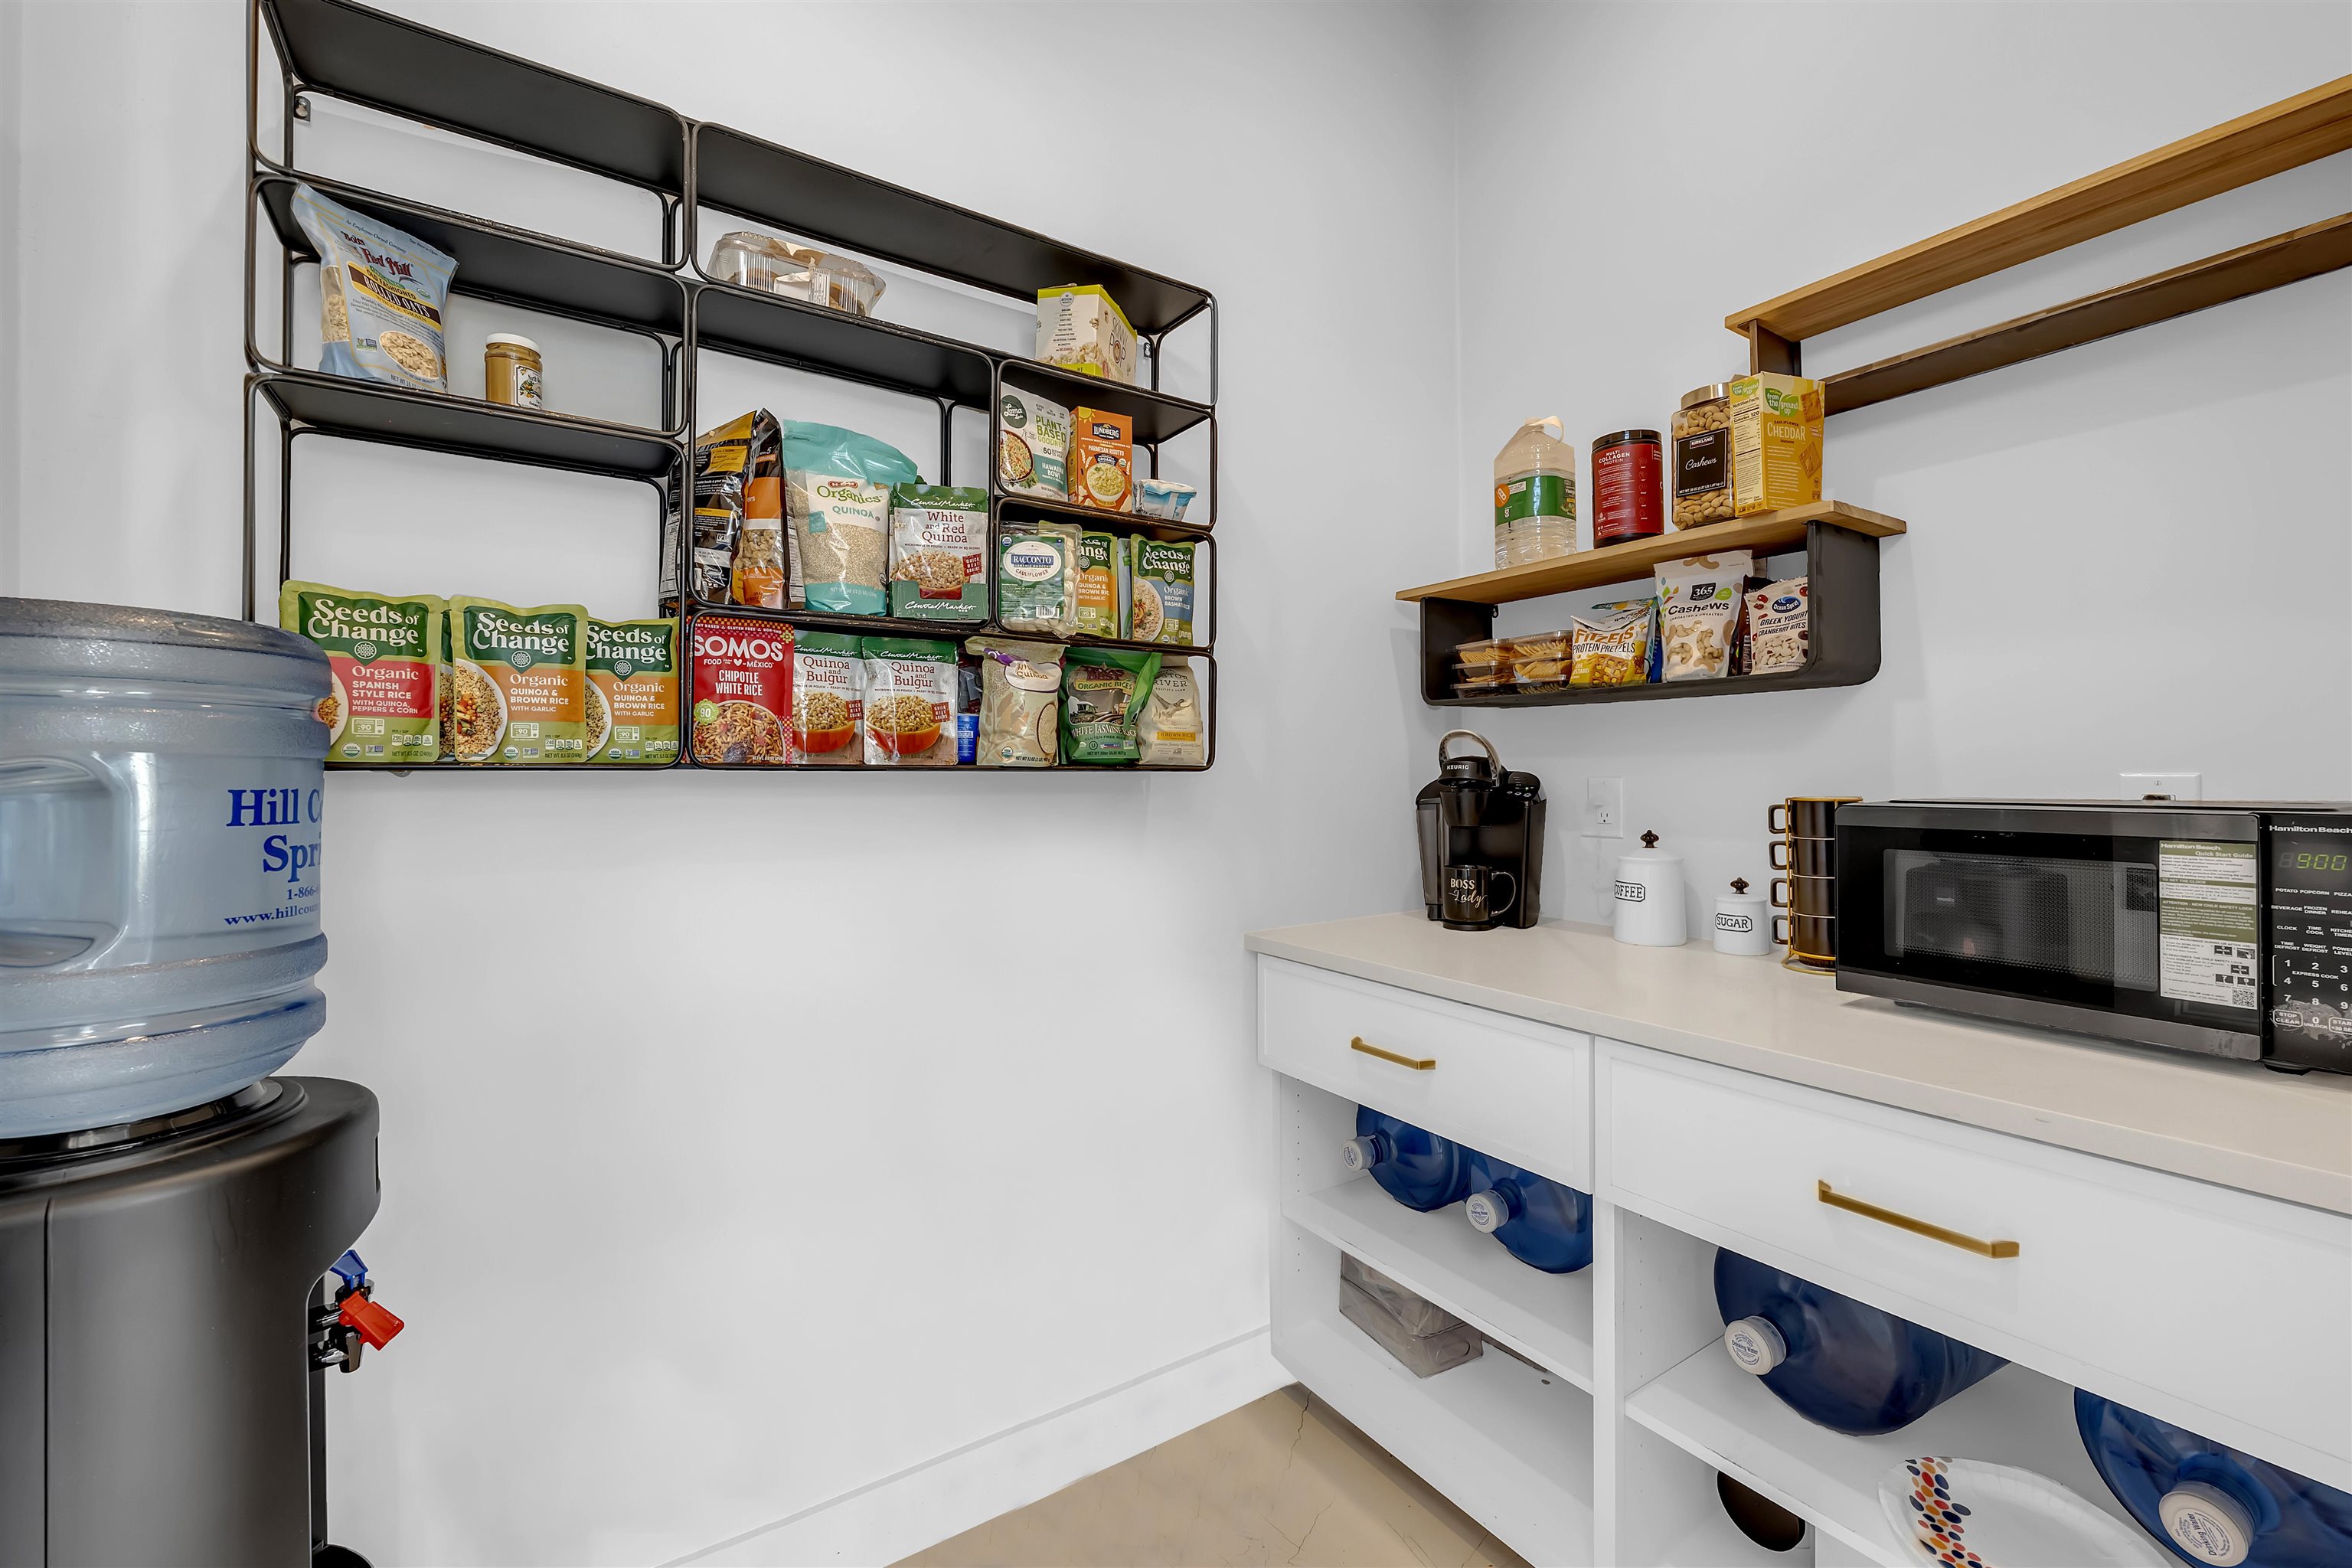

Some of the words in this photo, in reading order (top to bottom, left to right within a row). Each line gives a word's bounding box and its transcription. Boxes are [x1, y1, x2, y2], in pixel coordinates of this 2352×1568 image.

[360, 247, 386, 267] Red
[385, 257, 413, 277] Mill
[366, 269, 379, 282] OLD
[380, 277, 416, 300] FASHIONED
[363, 275, 401, 305] ROLLED
[403, 299, 430, 318] OATS
[1743, 383, 1759, 394] ground
[1004, 403, 1023, 416] Loma
[1769, 399, 1778, 407] the
[1780, 401, 1798, 410] ground
[1036, 415, 1066, 431] PLANT-
[1037, 425, 1067, 443] BASED
[1094, 426, 1119, 439] LUNDBERG
[1767, 423, 1806, 441] CHEDDAR
[1691, 436, 1713, 445] KIRKLAND
[1599, 452, 1630, 464] COLLAGEN
[1685, 456, 1717, 471] Cashews
[1047, 469, 1061, 480] BOWL
[817, 485, 881, 504] Organics
[911, 498, 942, 507] Central
[942, 499, 975, 508] Market
[832, 505, 874, 519] QUINOA
[926, 511, 964, 522] White
[942, 523, 965, 534] Red
[922, 531, 968, 544] Quinoa
[1145, 544, 1184, 560] Seeds
[1142, 557, 1191, 574] Change
[1164, 586, 1189, 596] Organic
[1693, 586, 1713, 596] 365
[905, 601, 939, 609] Central
[938, 602, 976, 610] Market
[1668, 602, 1730, 615] Cashews
[1786, 599, 1800, 609] Spray
[314, 599, 403, 626] Seeds
[405, 615, 420, 626] of
[1760, 617, 1782, 626] GREEK
[1784, 611, 1808, 622] YOGURT
[477, 612, 554, 634] Seeds
[556, 625, 570, 634] of
[1758, 626, 1789, 636] CRANBERRY
[1791, 622, 1806, 630] BITES
[308, 616, 419, 647] Change
[586, 625, 652, 644] Seeds
[654, 635, 667, 644] of
[473, 629, 570, 655] Change
[694, 635, 783, 662] SOMOS
[1573, 643, 1600, 654] PROTEIN
[1600, 642, 1635, 653] PRETZELS
[586, 641, 667, 664] Change
[746, 660, 773, 668] MÉXICO
[803, 656, 850, 670] Quinoa
[891, 662, 935, 674] Quinoa
[351, 665, 419, 681] Organic
[719, 669, 759, 684] CHIPOTLE
[806, 671, 848, 685] Bulgur
[352, 681, 399, 690] SPANISH
[510, 674, 569, 687] Organic
[613, 681, 665, 694] Organic
[894, 675, 933, 689] Bulgur
[1115, 681, 1132, 690] RICES
[352, 690, 385, 698] STYLE
[387, 691, 412, 700] RICE
[715, 681, 743, 695] WHITE
[743, 684, 763, 696] RICE
[376, 700, 410, 708] QUINOA,
[700, 707, 711, 718] 90
[1071, 726, 1093, 739] WHITE
[1094, 724, 1122, 735] JASMINE
[1122, 728, 1137, 737] RICE
[226, 788, 300, 827] Hill
[1450, 878, 1475, 890] BOSS
[1615, 884, 1643, 899] COFFEE
[1448, 890, 1488, 908] Lady
[1717, 916, 1748, 929] SUGAR
[1732, 1340, 1746, 1351] Drinking
[2187, 1513, 2201, 1530] Water
[2198, 1531, 2216, 1556] Drinking
